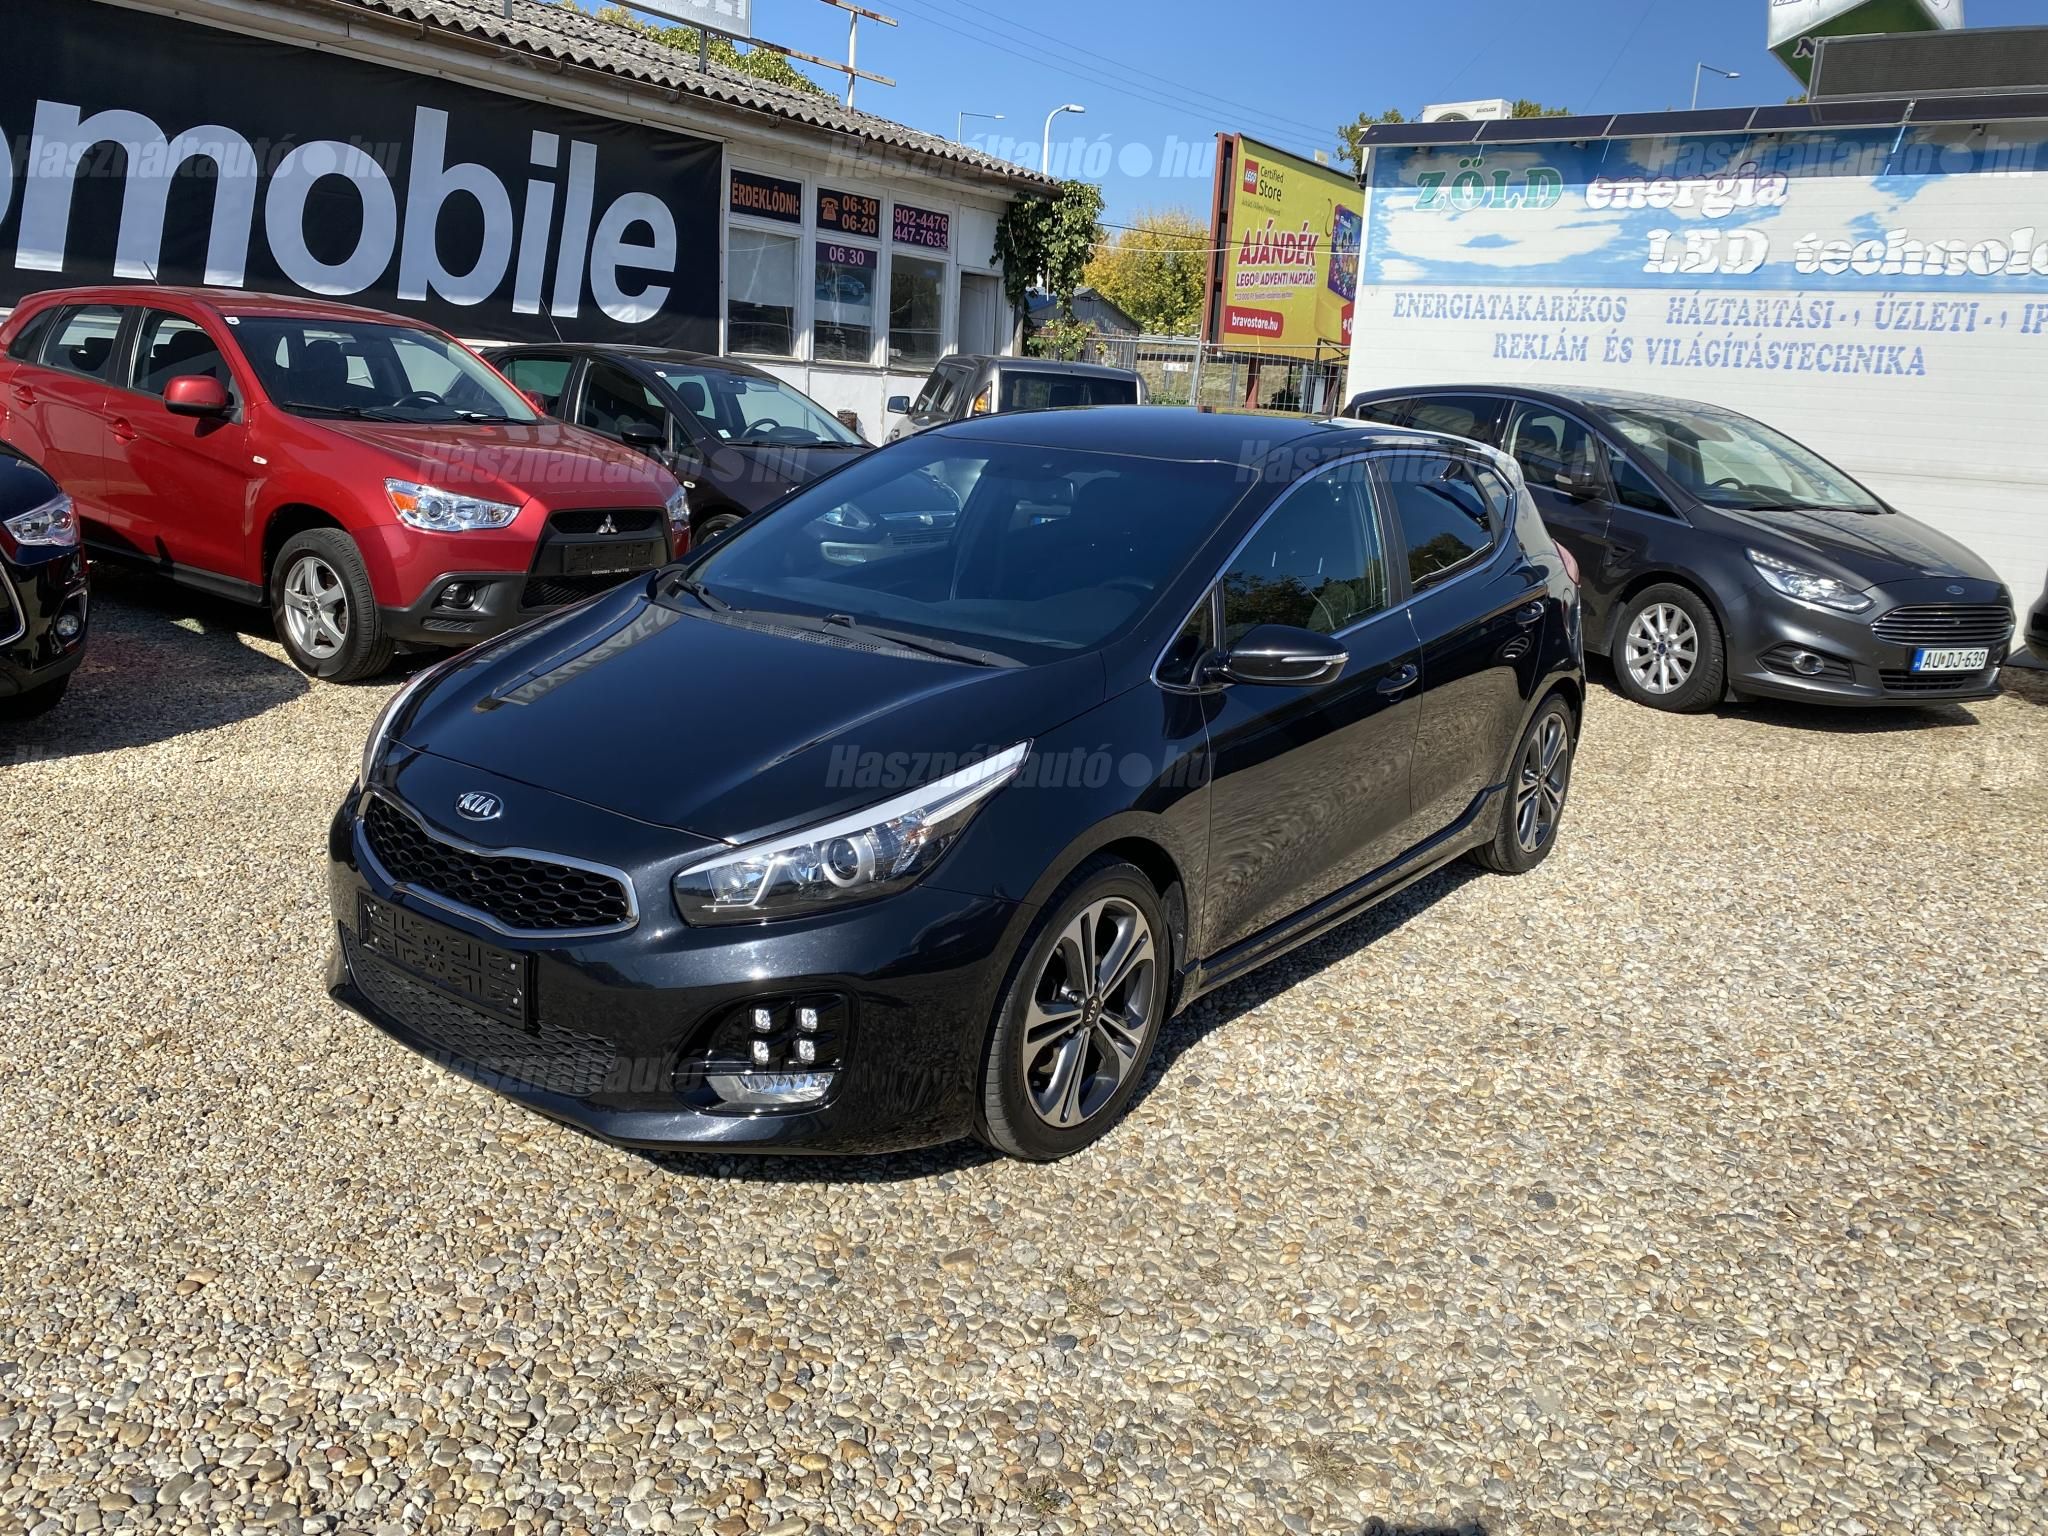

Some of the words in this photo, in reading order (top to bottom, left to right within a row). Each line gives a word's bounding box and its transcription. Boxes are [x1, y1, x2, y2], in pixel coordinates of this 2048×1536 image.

[1260, 166, 1284, 184] Certified
[731, 178, 800, 216] ÉRDEKLŐDNI:
[1259, 179, 1282, 202] Store
[1413, 157, 1564, 213] ZÖLD
[1585, 162, 1790, 219] energia
[0, 99, 677, 324] mobile
[841, 195, 877, 216] 06-30
[841, 216, 877, 234] 06-20
[894, 208, 949, 231] 902-4476
[894, 227, 949, 248] 447-7633
[1238, 219, 1320, 267] AJÁNDÉK
[828, 246, 846, 263] 06
[848, 250, 865, 266] 30
[1643, 228, 1770, 275] LED
[1260, 272, 1289, 286] ADVENTI
[1393, 289, 1628, 323] ENERGIATAKARÉKOS
[1231, 313, 1279, 331] bravostore.hu
[1493, 327, 1590, 362] REKLÁM
[1602, 328, 1635, 364] ÉS
[1645, 332, 1927, 376] VILÁGÍTÁSTECHNIKA
[1923, 652, 1942, 669] AU
[1944, 651, 1986, 669] DJ-639
[459, 793, 496, 817] KIA
